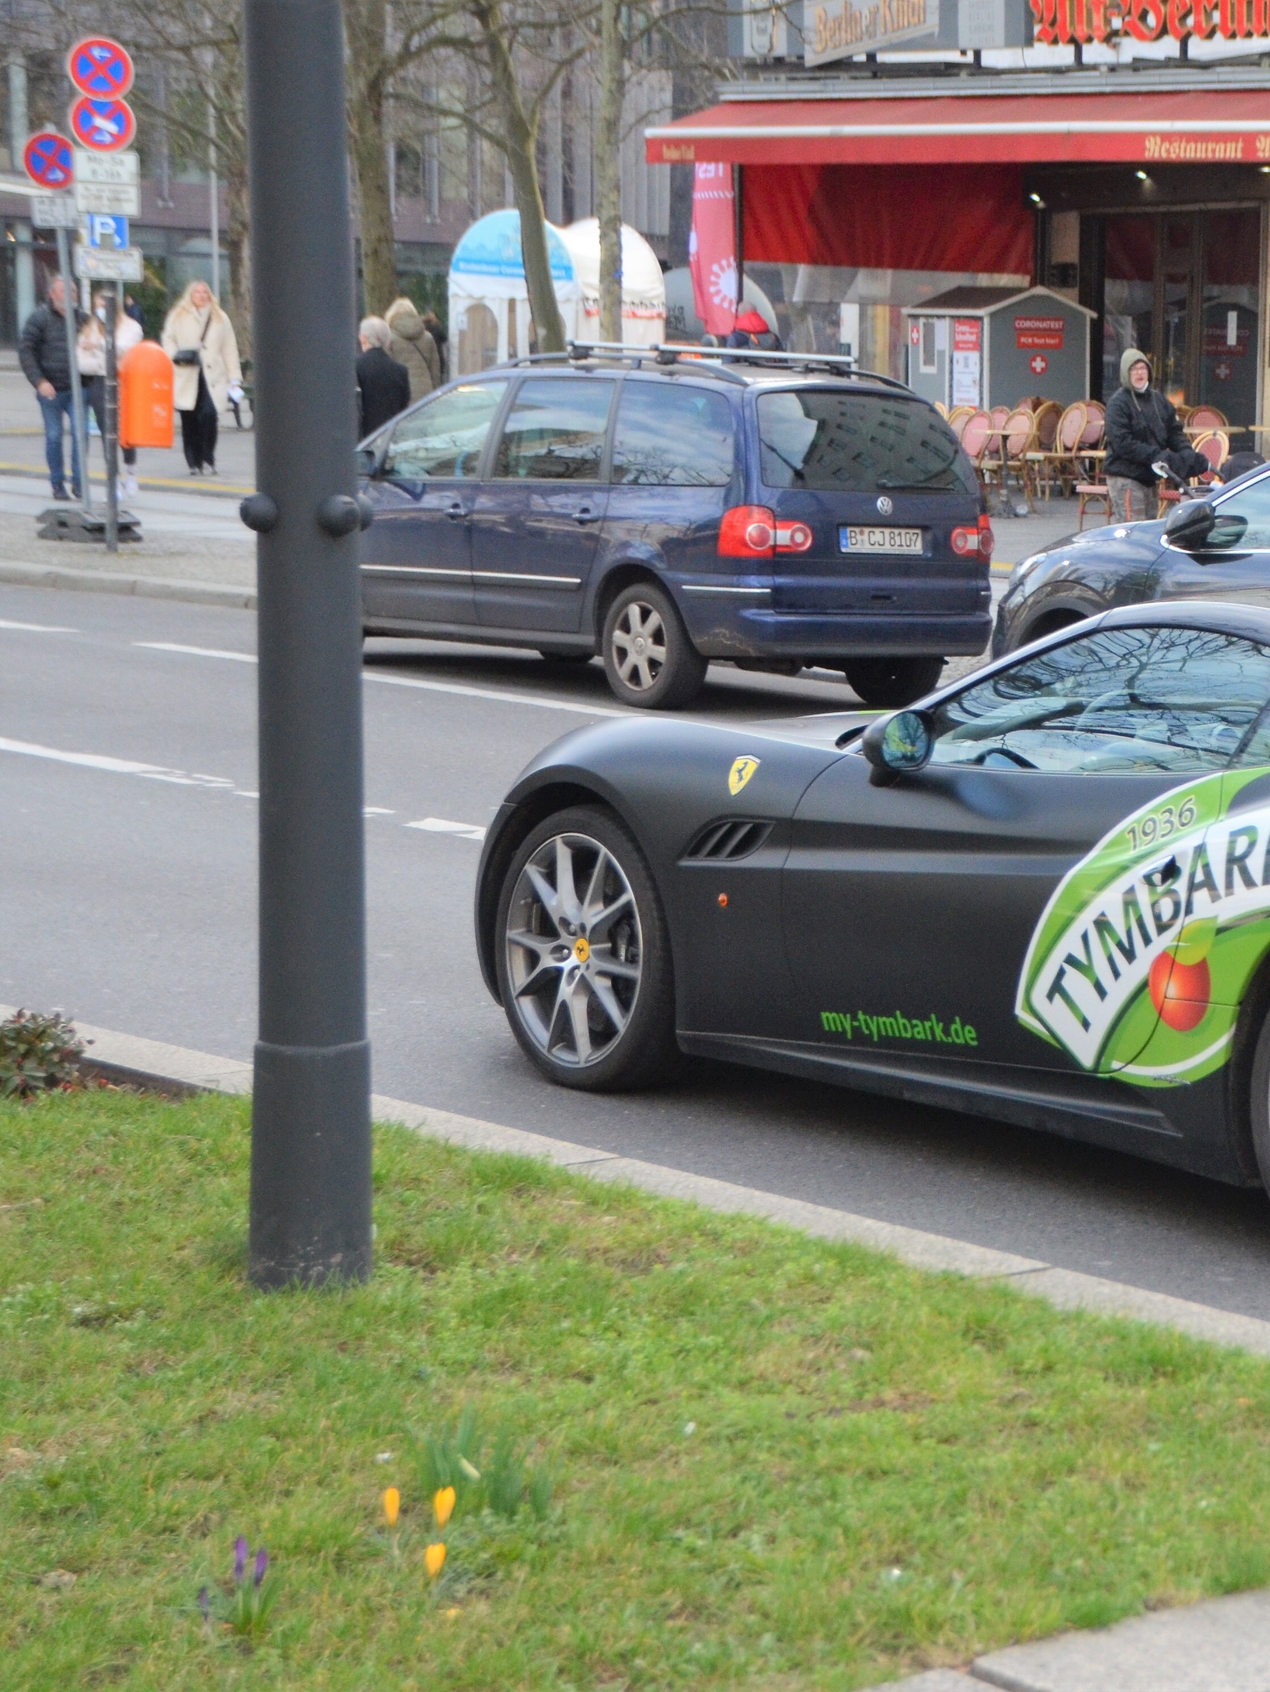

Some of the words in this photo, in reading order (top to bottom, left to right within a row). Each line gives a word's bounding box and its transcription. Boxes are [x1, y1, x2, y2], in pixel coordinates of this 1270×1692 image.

[1144, 135, 1244, 158] Restaurant
[1014, 319, 1063, 329] CORONATEST
[1020, 336, 1032, 344] PCR
[1033, 336, 1045, 344] Test
[849, 529, 858, 546] B
[867, 530, 885, 546] CJ
[889, 531, 919, 547] 8107
[1124, 796, 1197, 850] 1936
[820, 1010, 978, 1046] my-tymbark.de
